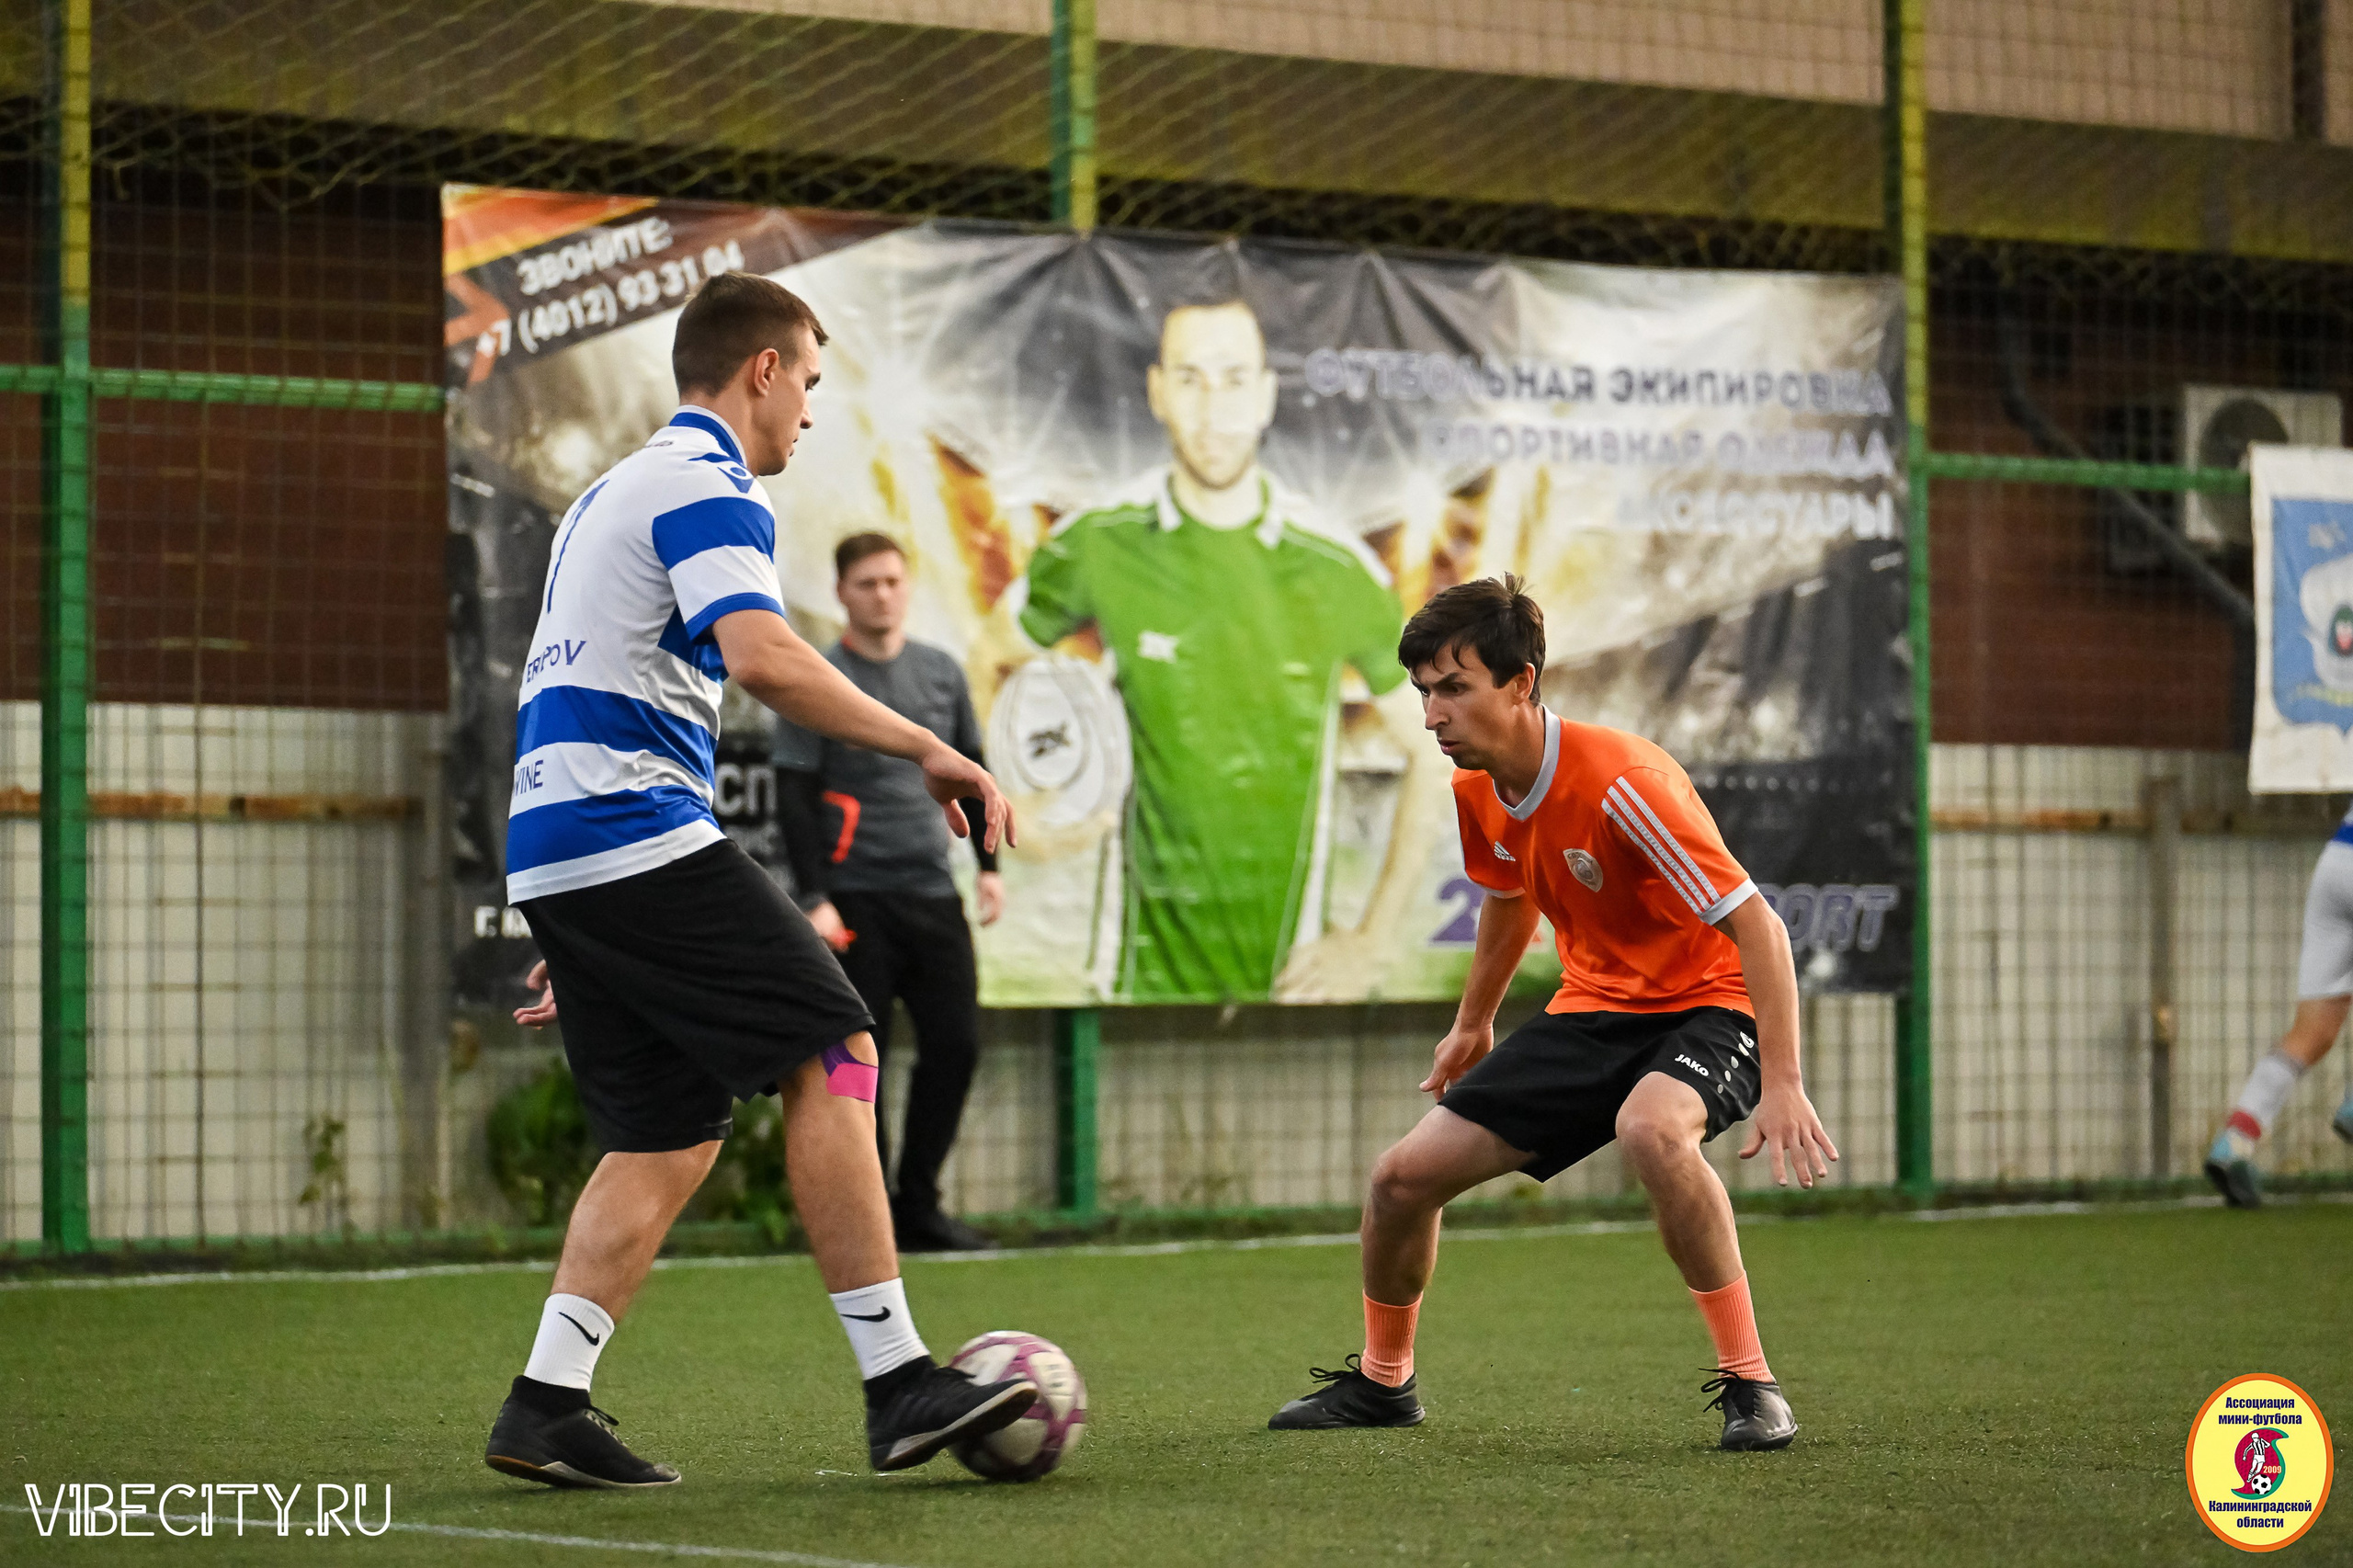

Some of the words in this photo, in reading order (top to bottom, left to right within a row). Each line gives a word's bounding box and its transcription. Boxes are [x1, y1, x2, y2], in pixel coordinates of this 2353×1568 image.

[517, 283, 619, 354] (4012)
[1609, 366, 1894, 417] ЭКИПИРОВКА
[1675, 1053, 1710, 1077] JAKO
